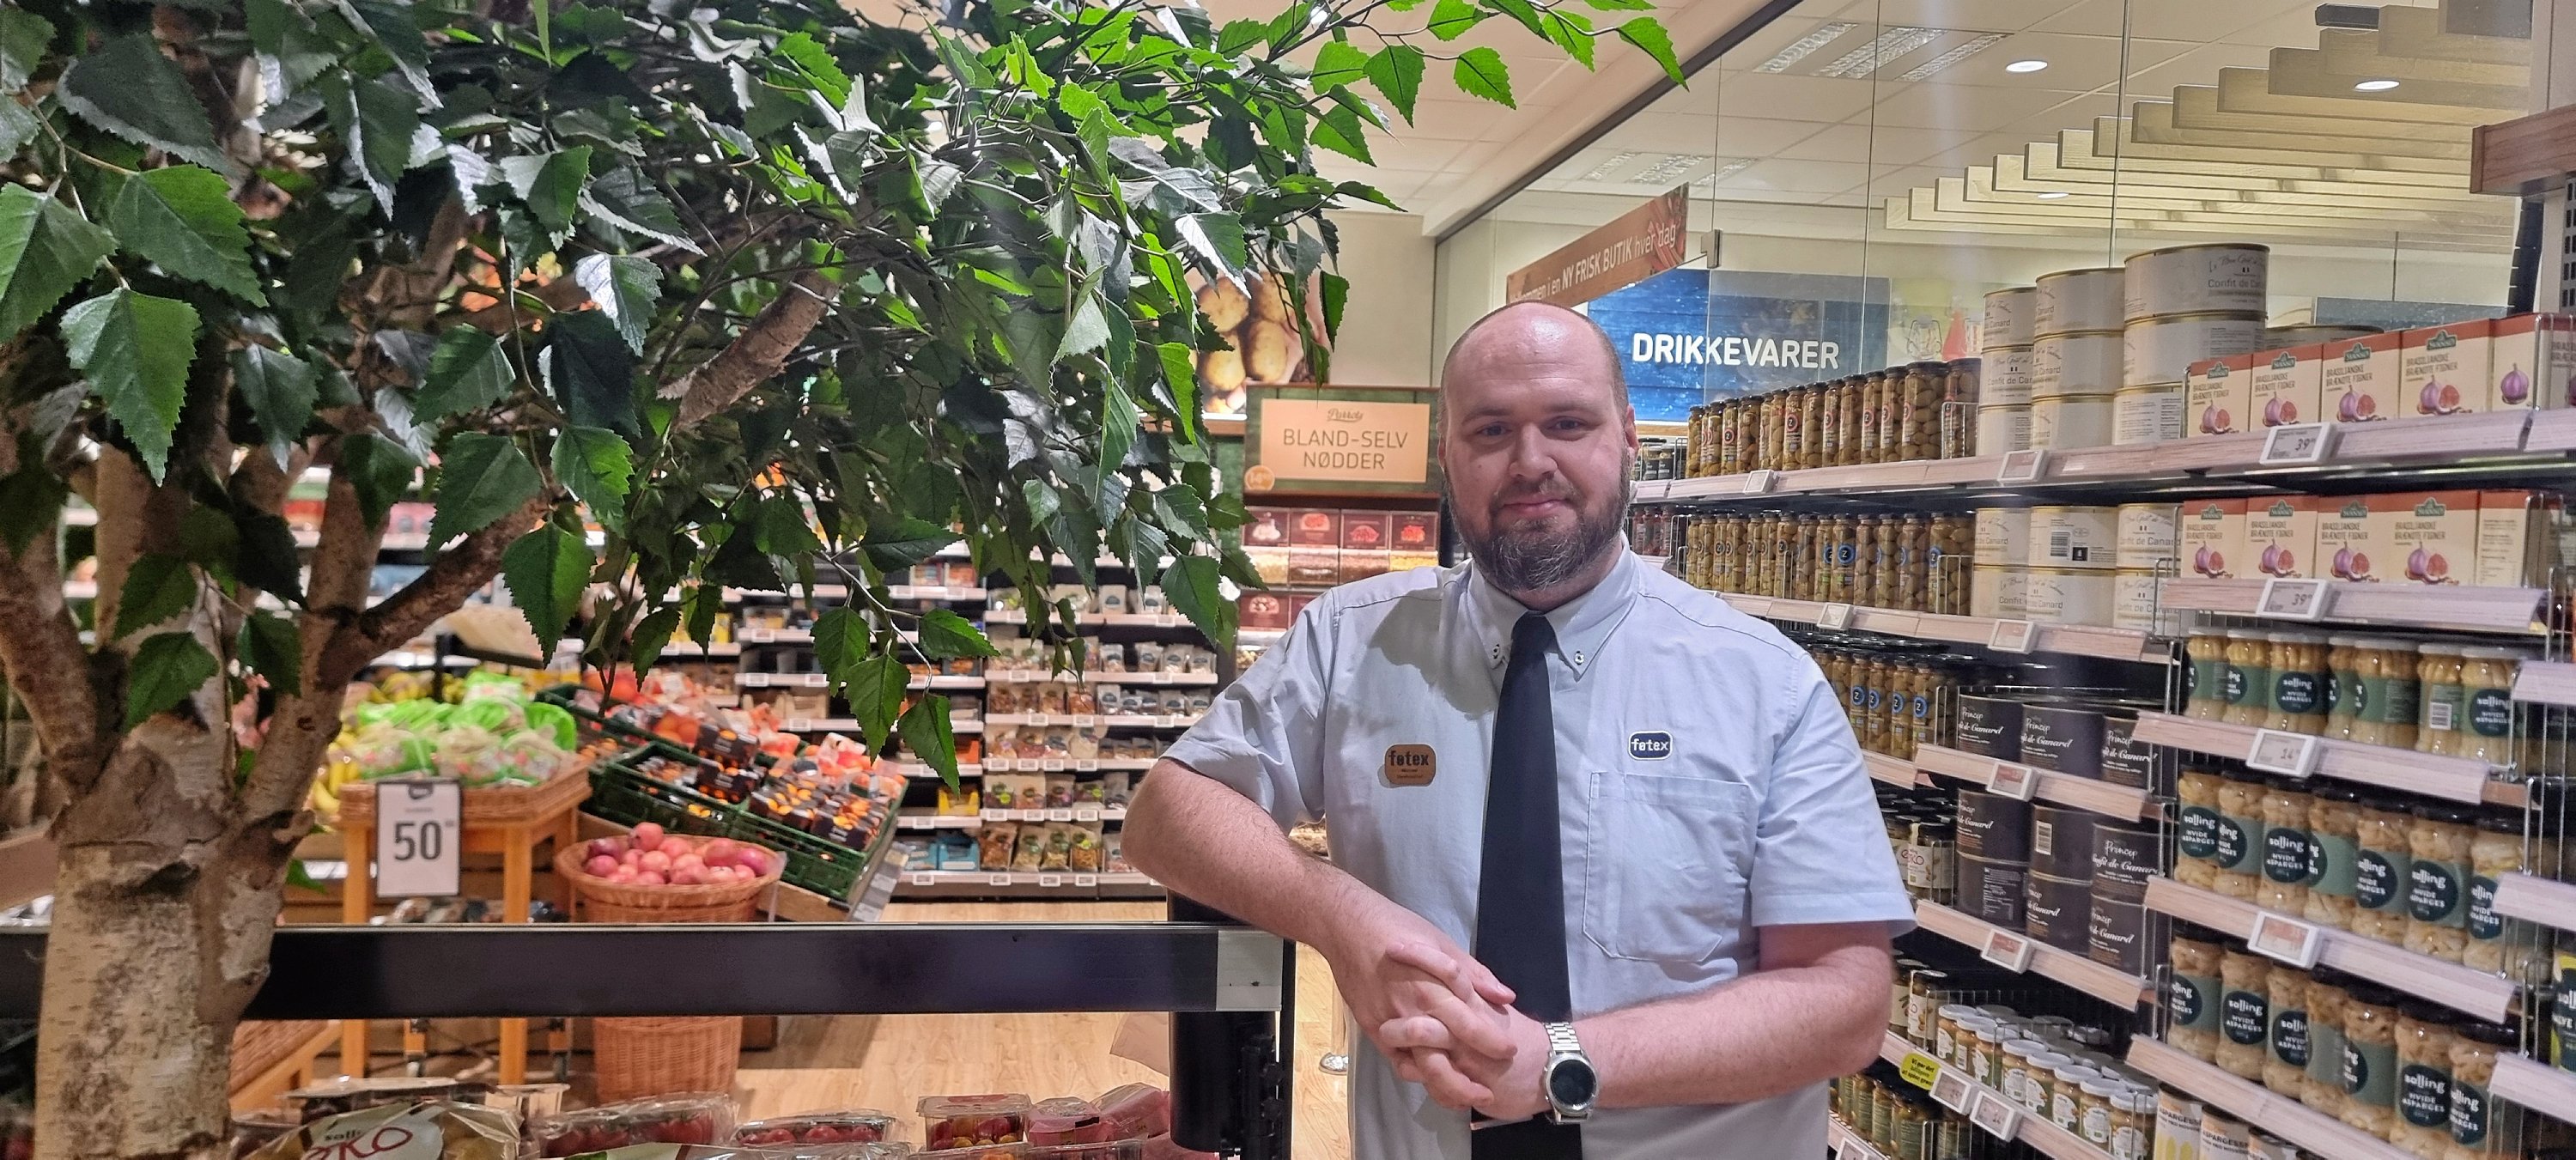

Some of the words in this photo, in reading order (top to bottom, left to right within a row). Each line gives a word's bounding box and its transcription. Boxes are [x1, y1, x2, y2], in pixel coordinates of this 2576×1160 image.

[1552, 278, 1561, 295] en
[1563, 267, 1574, 289] NY
[1576, 252, 1601, 284] FRISK
[1603, 237, 1633, 270] BUTIK
[1635, 232, 1656, 256] hver
[1658, 222, 1676, 248] dag
[2208, 278, 2237, 288] Confit
[2239, 279, 2249, 288] de
[1633, 332, 1839, 369] DRIKKEVARER
[2007, 376, 2017, 385] de
[1284, 428, 1408, 449] BLAND-SELV
[1303, 452, 1385, 471] NØDDER
[1985, 537, 2008, 545] Canard
[2136, 537, 2145, 545] de
[2038, 600, 2063, 609] Canard
[2283, 678, 2312, 689] salling
[1971, 723, 2004, 735] Canard
[1631, 738, 1669, 752] føtex
[2037, 736, 2074, 748] Canard
[1388, 750, 1429, 767] føtex
[1965, 817, 1994, 829] Canard
[2184, 814, 2215, 829] salling
[2182, 835, 2215, 845] ASPARGES
[2185, 829, 2208, 839] HVIDE
[395, 821, 442, 860] 50
[2269, 836, 2305, 853] salling
[2272, 853, 2296, 862] HVIDE
[2121, 862, 2159, 874] Canar
[2266, 859, 2304, 870] ASPARGES
[2411, 869, 2446, 889] salling
[2032, 903, 2061, 917] Canard
[2100, 929, 2135, 944] Canard
[2558, 990, 2576, 1010] sall
[2228, 999, 2263, 1017] salling
[2226, 1020, 2263, 1032] ASPARGES
[2232, 1016, 2255, 1025] HVIDE
[2281, 1018, 2306, 1030] salli
[2278, 1042, 2306, 1052] ASPAR
[2404, 1073, 2445, 1094] salling
[2409, 1093, 2436, 1103] HVIDE
[2402, 1098, 2445, 1113] ASPARGES
[325, 1129, 364, 1141] sall
